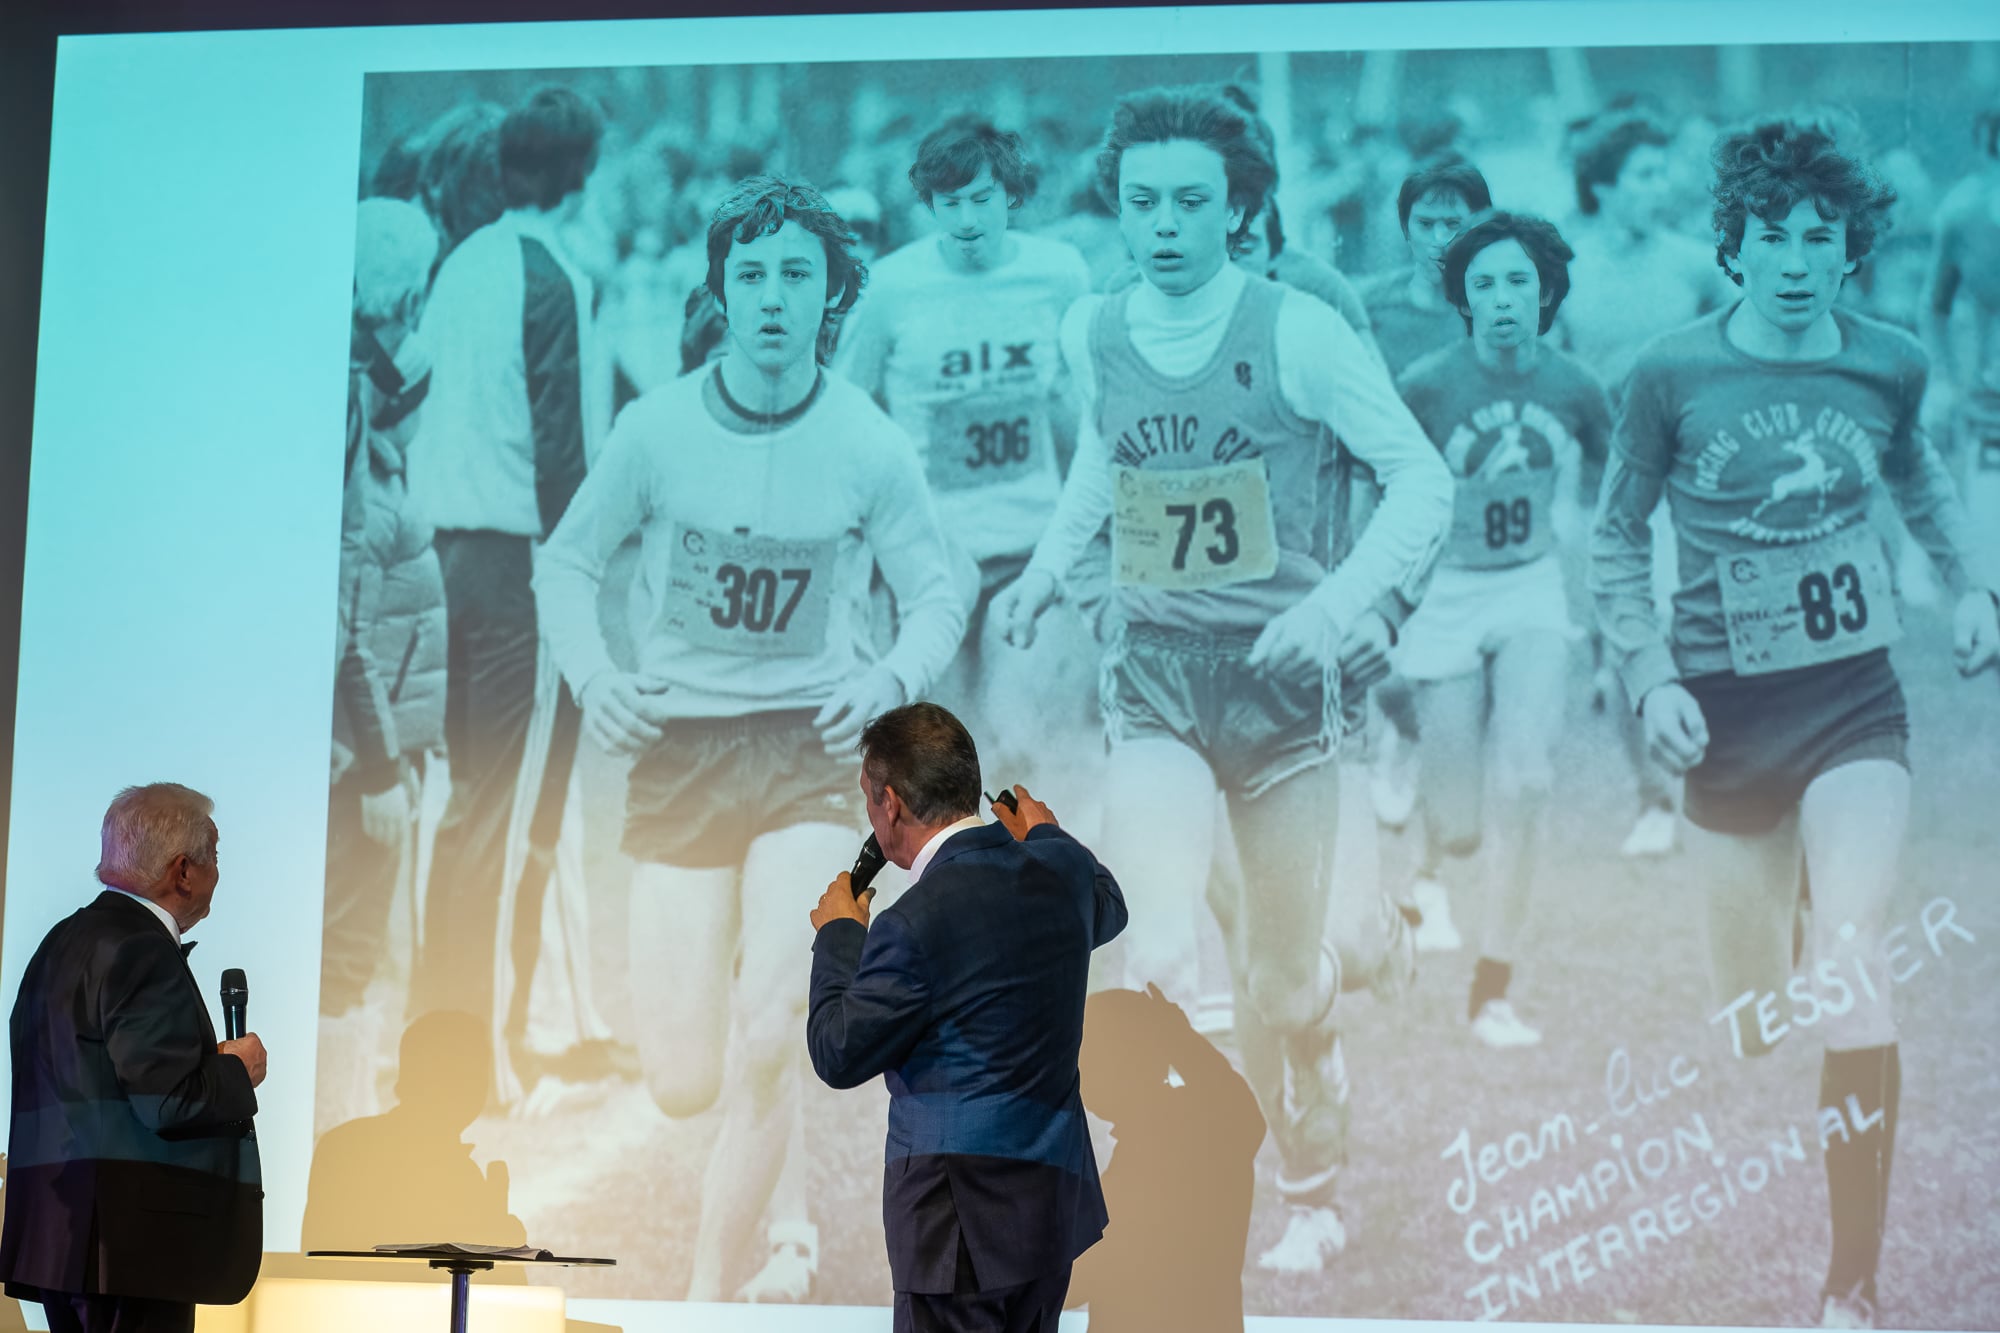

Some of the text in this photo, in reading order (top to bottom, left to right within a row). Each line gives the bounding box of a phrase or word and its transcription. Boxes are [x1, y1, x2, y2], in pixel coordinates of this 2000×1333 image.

[964, 416, 1030, 469] 306
[1165, 498, 1239, 570] 73
[1484, 497, 1531, 549] 89
[710, 562, 811, 632] 307
[1799, 564, 1867, 641] 83
